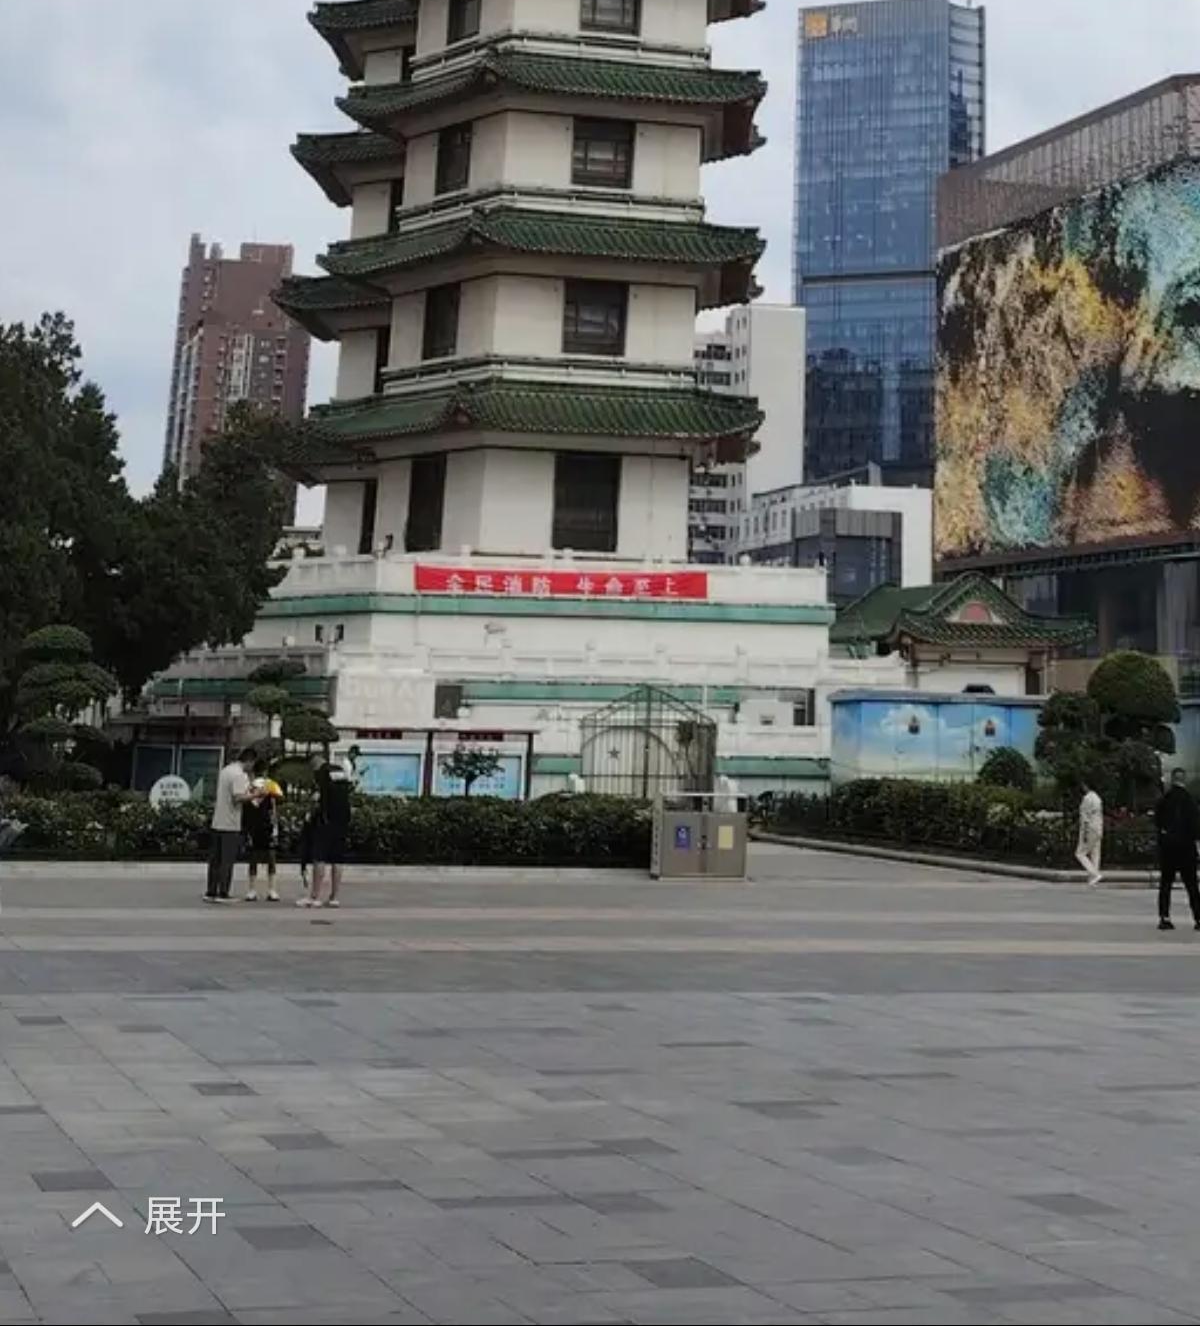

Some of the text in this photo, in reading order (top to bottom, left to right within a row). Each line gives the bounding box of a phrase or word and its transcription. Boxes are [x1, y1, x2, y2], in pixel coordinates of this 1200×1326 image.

[445, 572, 679, 597] 全民消防 生命至上
